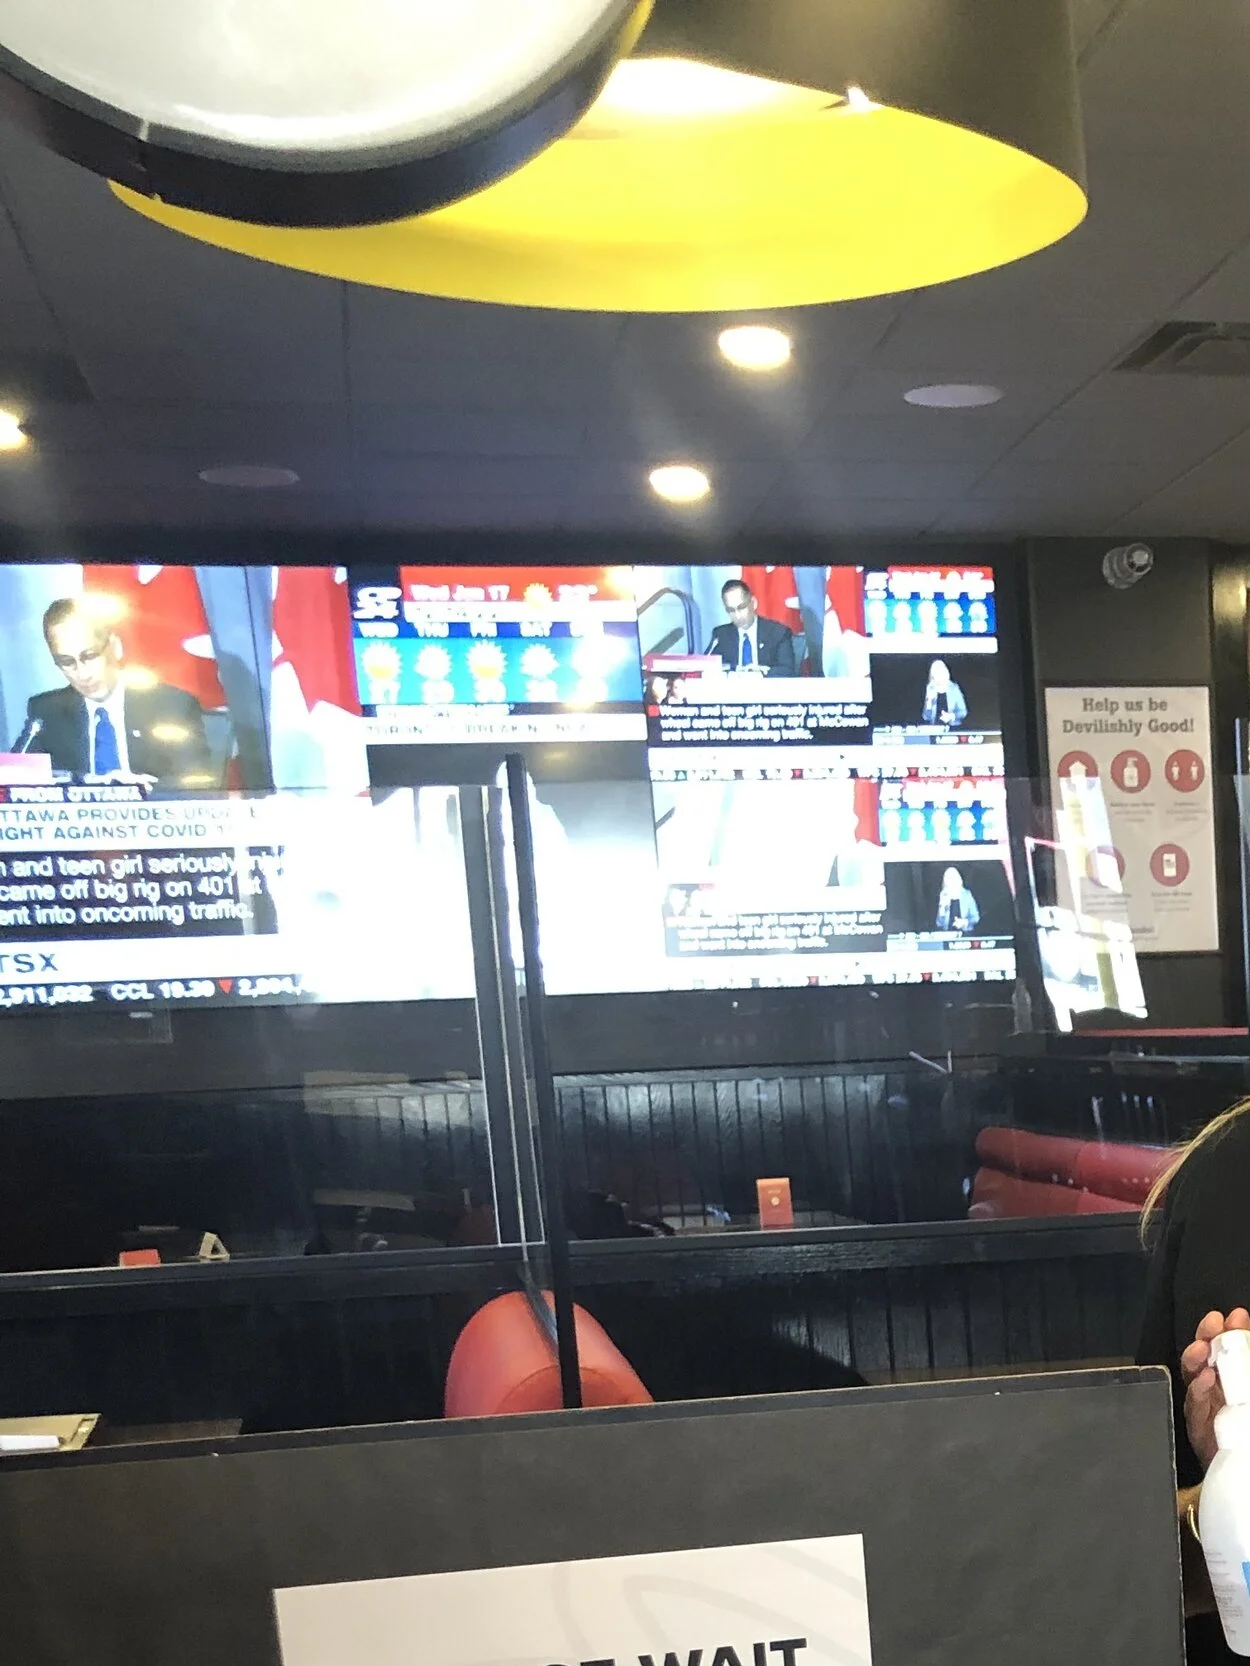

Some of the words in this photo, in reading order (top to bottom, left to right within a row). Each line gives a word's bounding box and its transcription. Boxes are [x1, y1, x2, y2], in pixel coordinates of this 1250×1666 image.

[1082, 697, 1120, 716] Help
[1124, 699, 1143, 712] us
[1149, 697, 1168, 712] be
[1062, 718, 1142, 737] Devilishly
[1148, 717, 1195, 734] Good!
[77, 806, 176, 821] PROVIDES
[54, 824, 138, 840] AGAINST
[12, 857, 52, 877] and
[58, 856, 105, 876] teen
[110, 853, 143, 879] girl
[148, 852, 238, 877] seriously
[61, 879, 90, 899] off
[94, 878, 128, 903] big
[133, 879, 160, 902] rig
[166, 880, 193, 897] on
[198, 876, 235, 896] 401
[35, 904, 76, 924] into
[81, 902, 185, 926] oncoming
